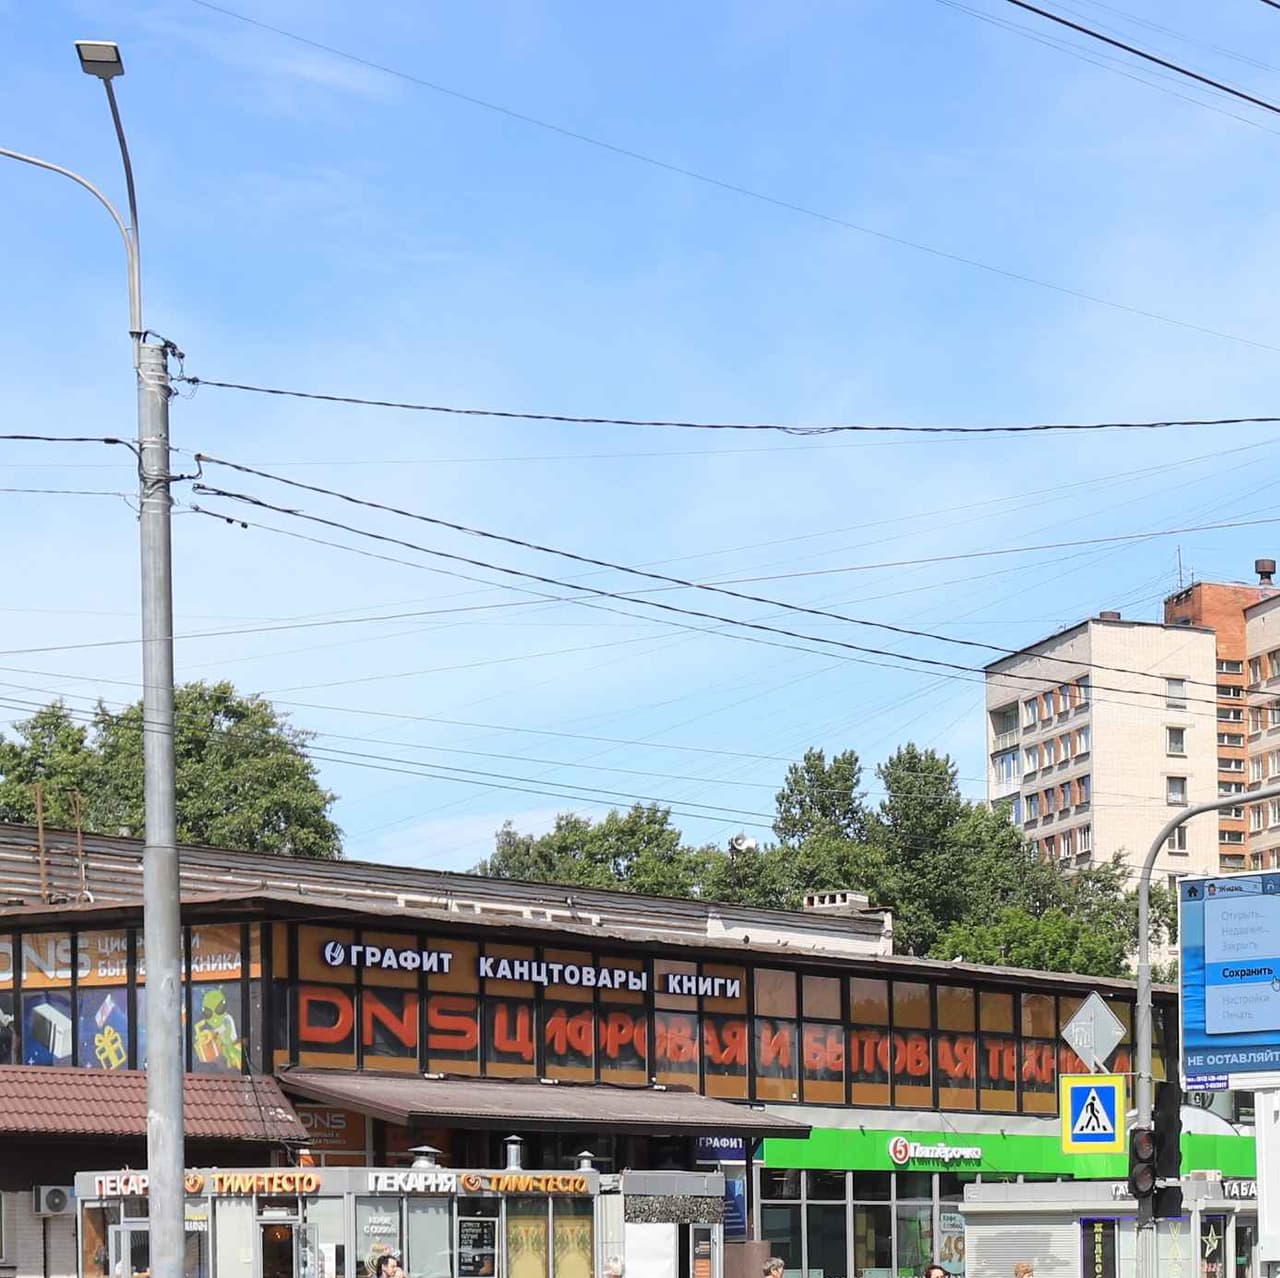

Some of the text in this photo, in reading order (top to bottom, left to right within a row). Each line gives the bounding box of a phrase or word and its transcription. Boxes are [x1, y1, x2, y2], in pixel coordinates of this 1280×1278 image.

[181, 952, 243, 973] ХНИКА
[351, 945, 740, 998] ГРАФИТ КАНЦТОВАРЫ КНИГИ
[1222, 966, 1274, 979] Сохранить
[299, 986, 1132, 1084] DNS ЦИФРОВАЯ И БЫТОВАЯ ТЕХНИА
[1187, 1055, 1204, 1067] НЕ
[699, 1137, 743, 1149] ГРАФИТ
[95, 1175, 148, 1196] ПЕКАР
[368, 1173, 456, 1192] ПЕКАРНЯ
[1223, 1182, 1258, 1197] ТАБА
